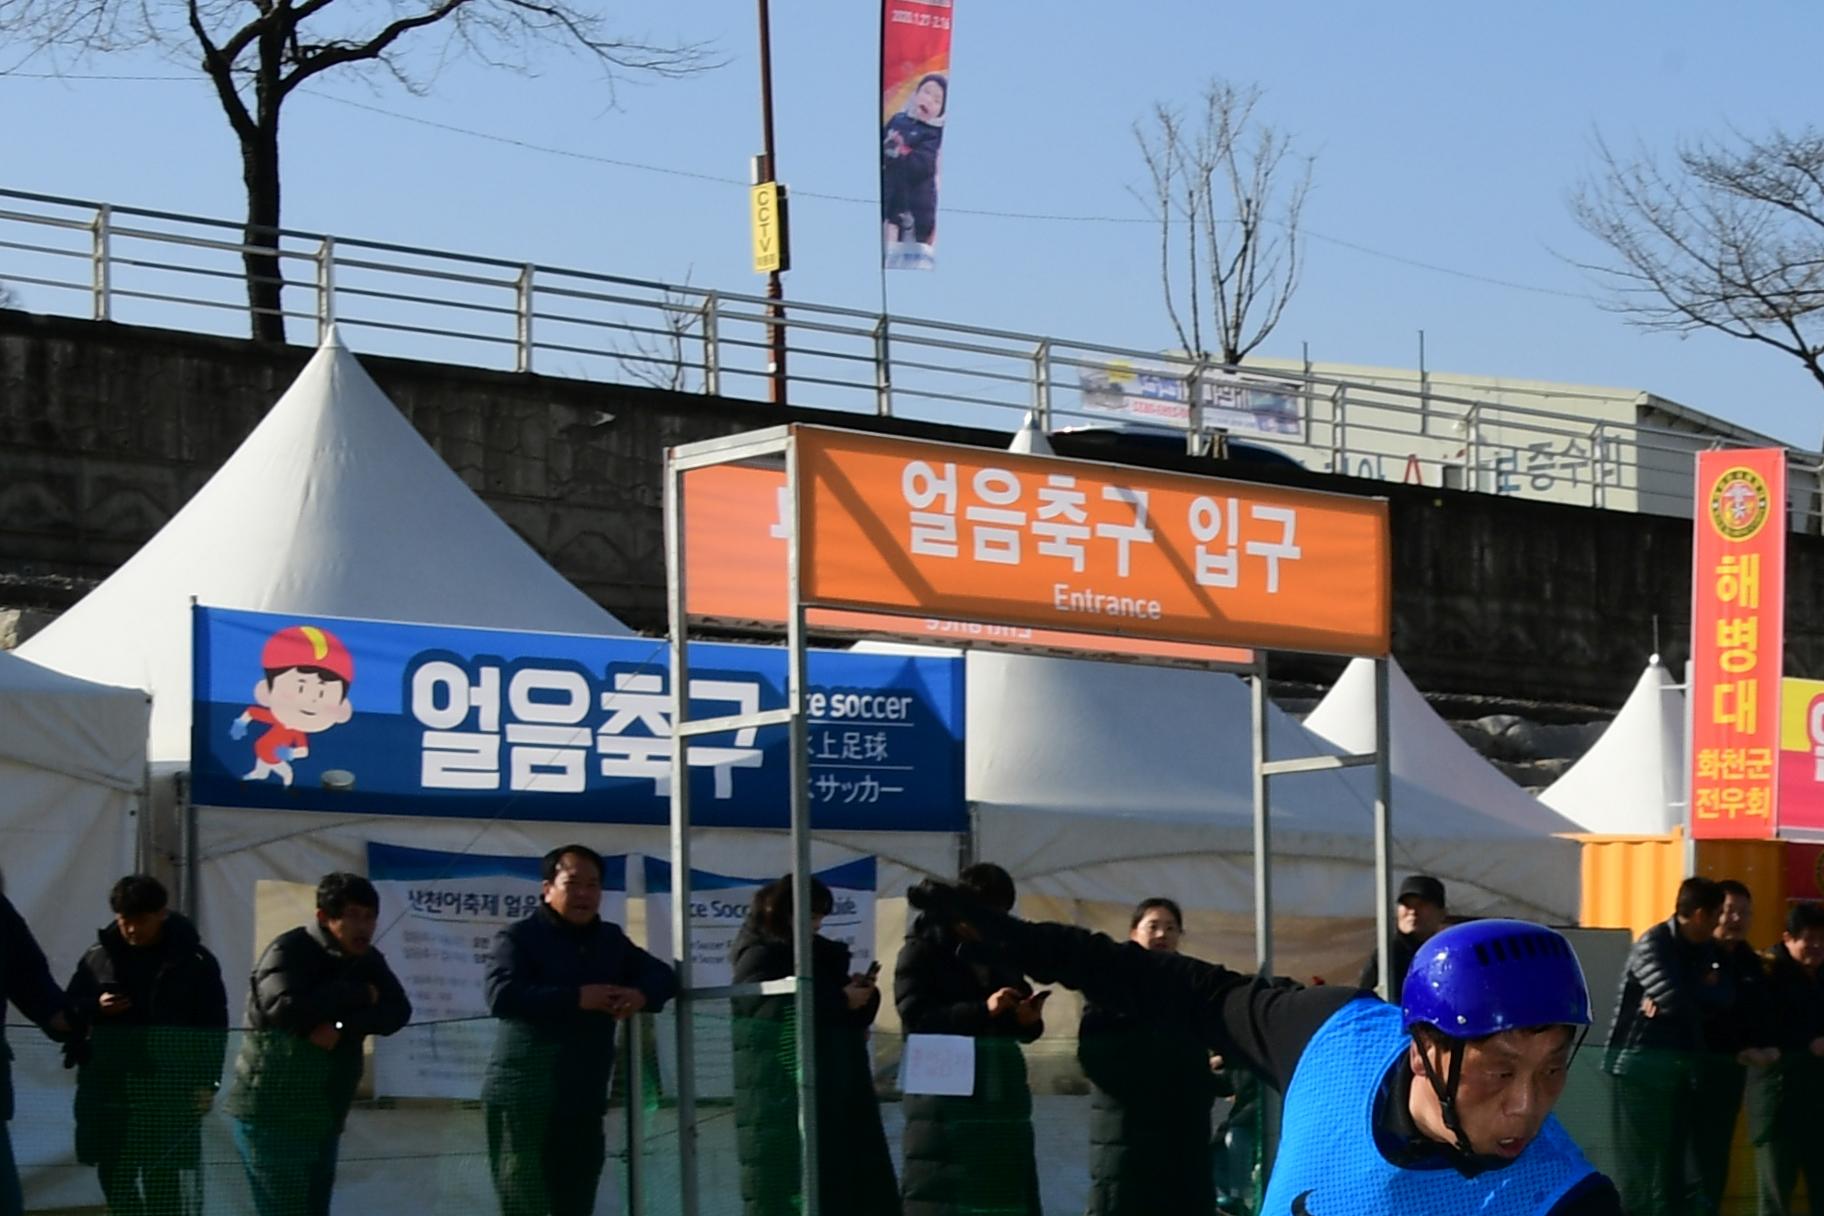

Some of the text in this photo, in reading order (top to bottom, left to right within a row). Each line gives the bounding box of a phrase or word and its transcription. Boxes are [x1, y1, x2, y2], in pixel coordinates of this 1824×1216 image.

[756, 190, 772, 253] CCTV
[901, 459, 1302, 593] 얼음축구 입구
[1053, 583, 1162, 619] Entrance
[1712, 553, 1762, 736] 해병대
[830, 692, 913, 720] soccer
[411, 660, 764, 800] 얼음축구
[1696, 747, 1774, 781] 화천군
[1695, 786, 1771, 819] 전우회
[503, 894, 541, 918] 얼음
[689, 901, 708, 918] ce
